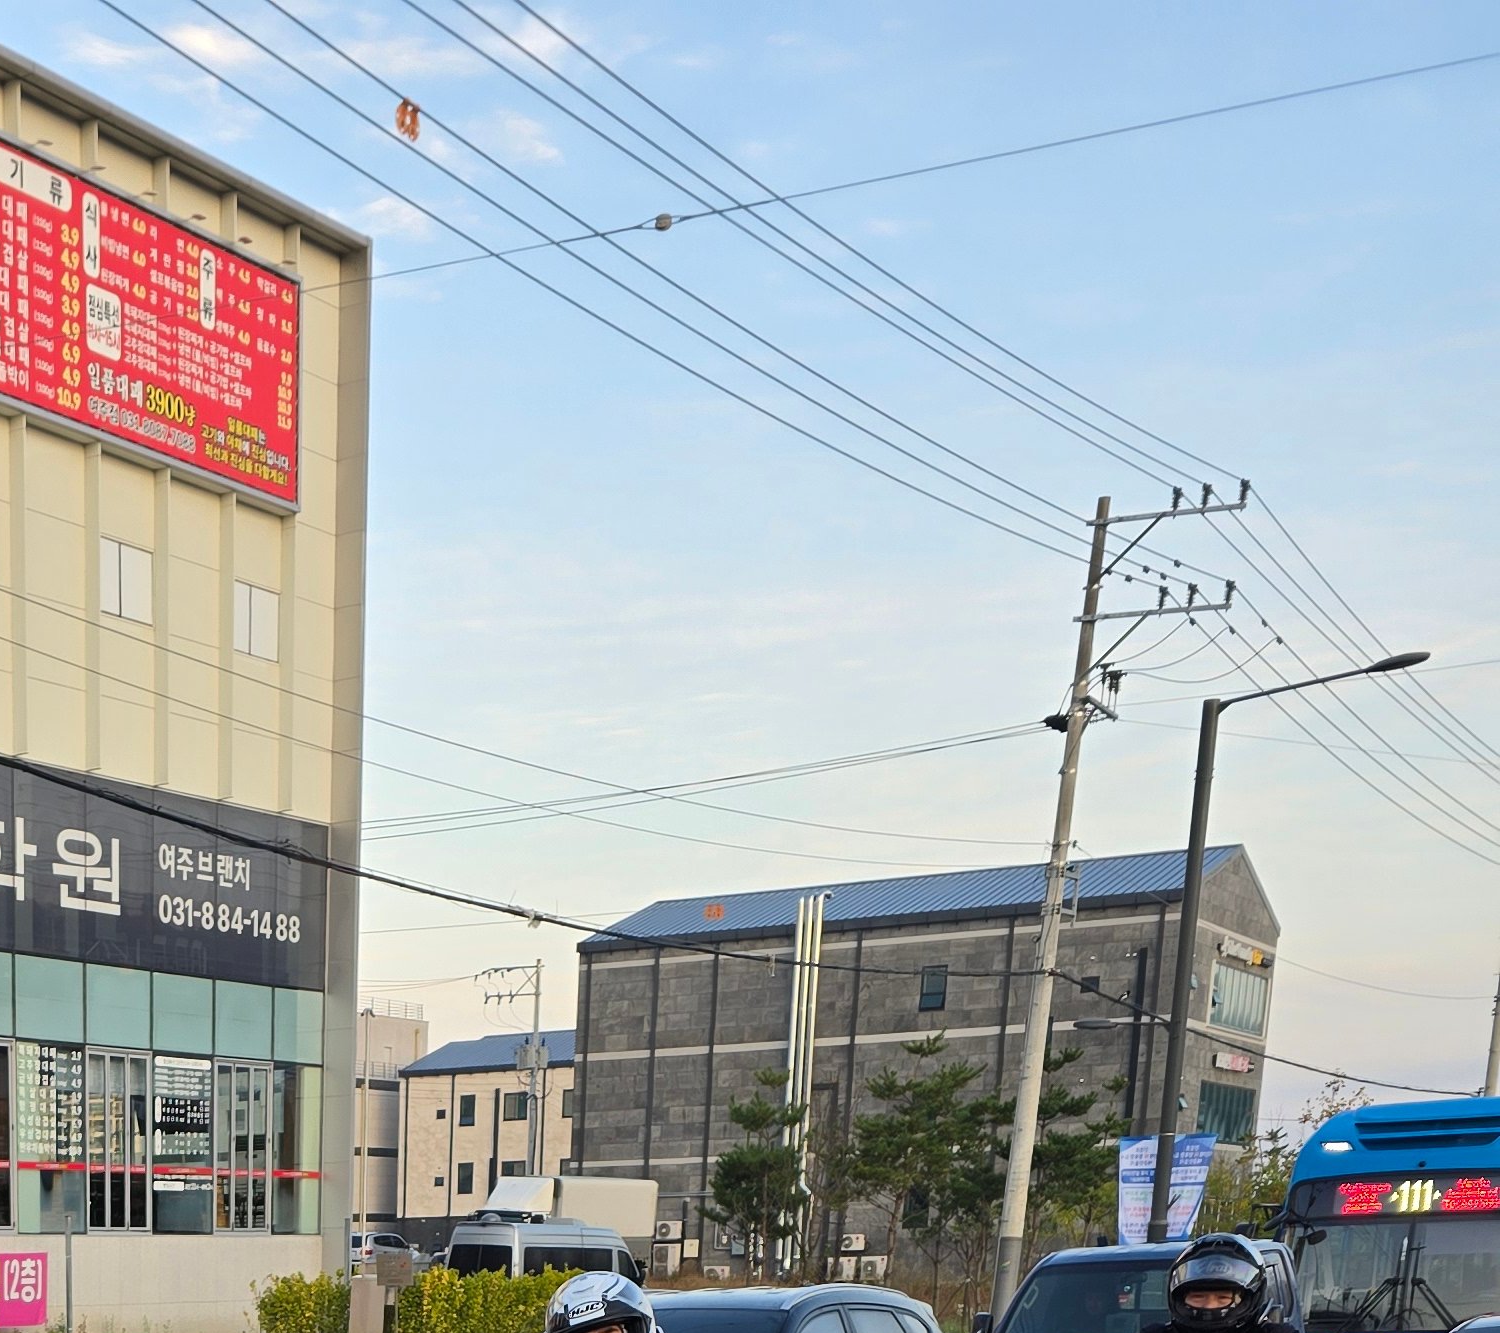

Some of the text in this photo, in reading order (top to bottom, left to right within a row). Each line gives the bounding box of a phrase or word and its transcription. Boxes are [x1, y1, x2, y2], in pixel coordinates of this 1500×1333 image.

[88, 362, 197, 427] 일품대패 3900냥
[3, 1258, 43, 1303] (2층)
[571, 1301, 604, 1319] HJC
